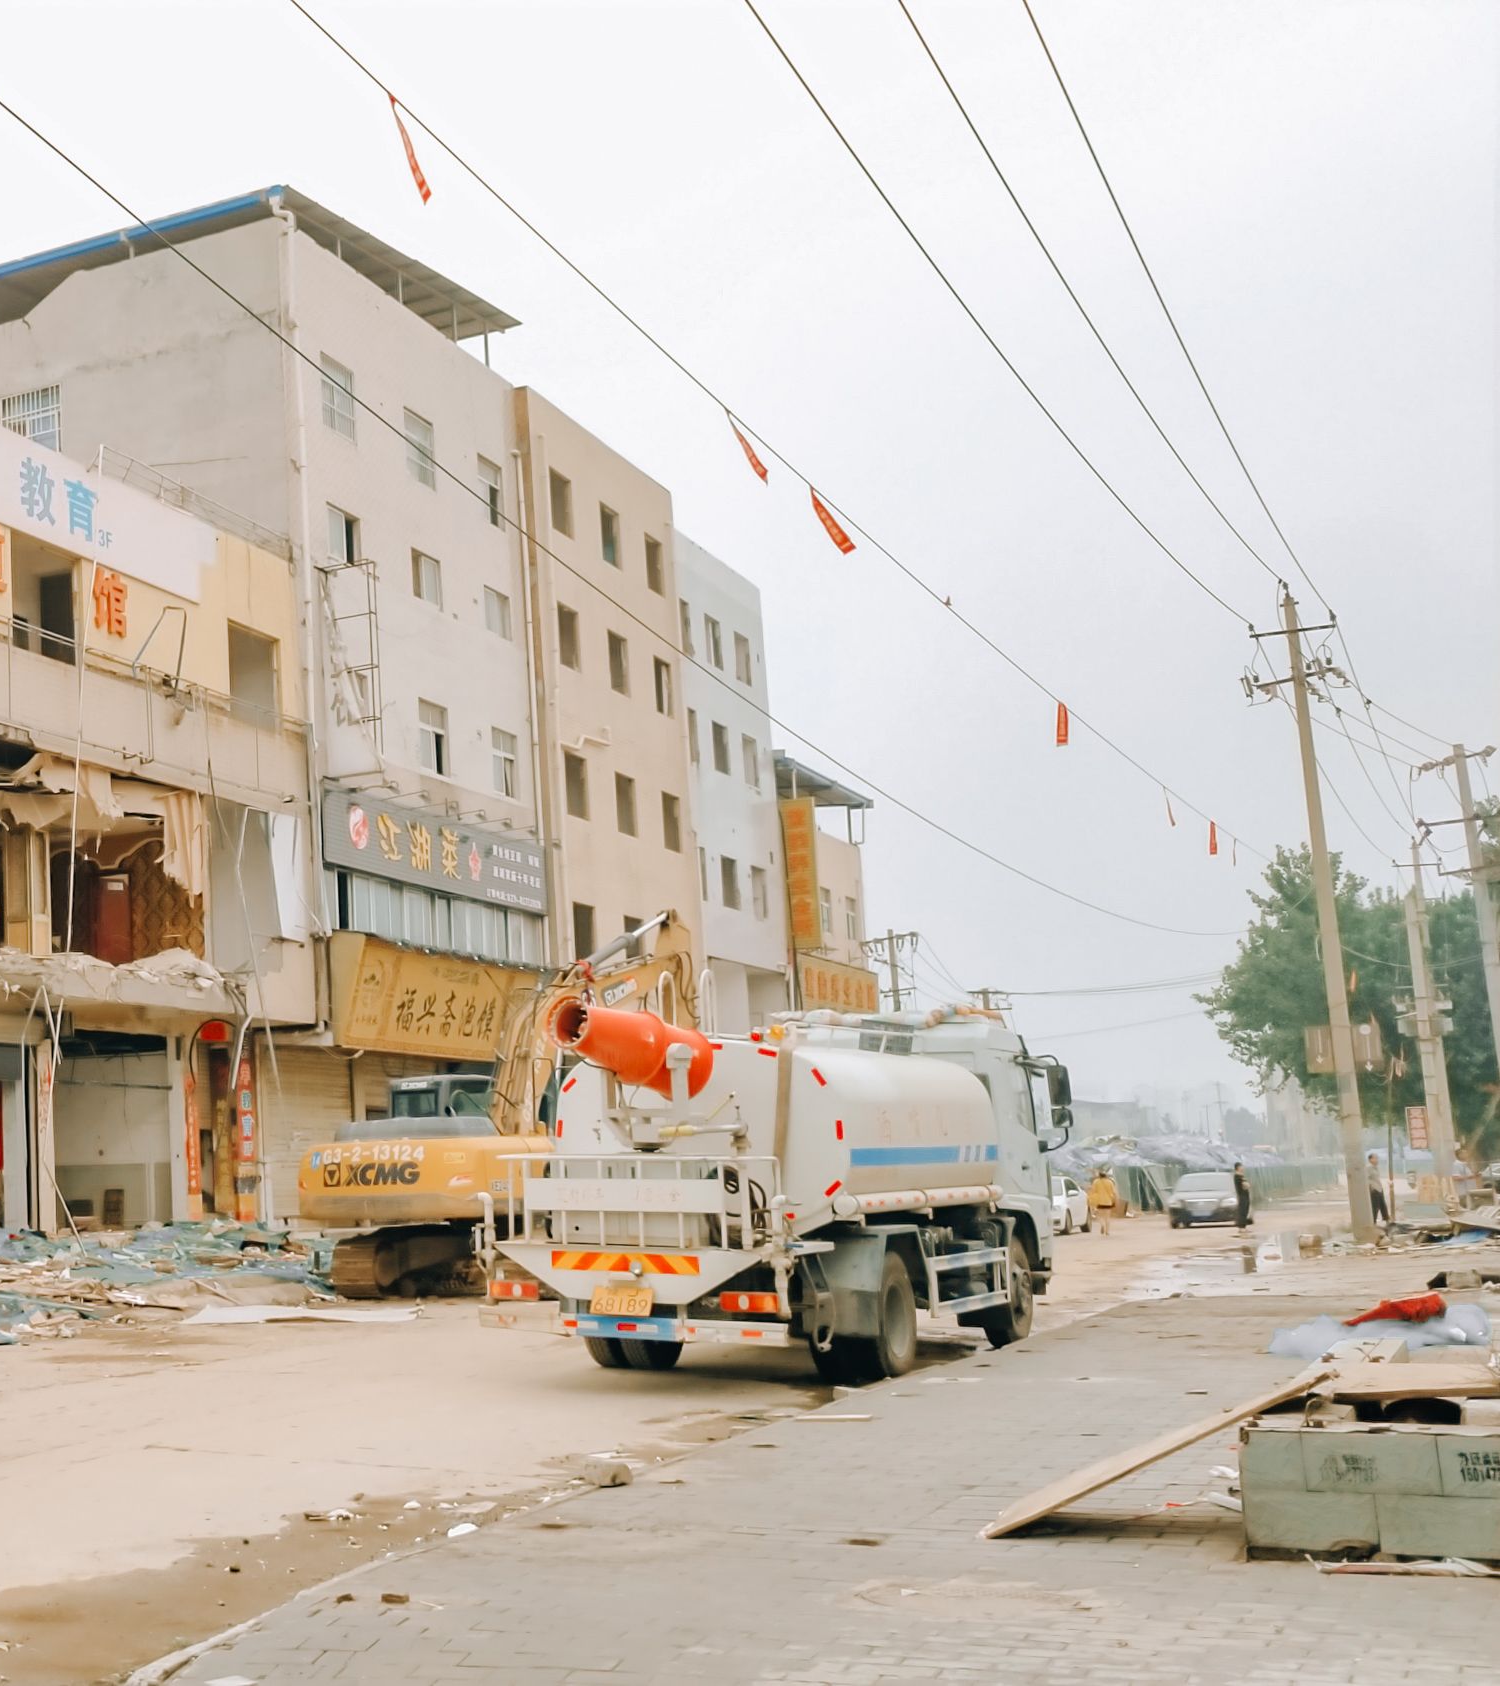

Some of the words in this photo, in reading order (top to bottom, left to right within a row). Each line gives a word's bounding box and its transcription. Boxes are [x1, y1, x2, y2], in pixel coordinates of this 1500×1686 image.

[19, 456, 98, 543] 教育
[98, 529, 113, 549] 3F
[323, 1145, 425, 1165] G3-2-13124
[343, 1161, 421, 1187] XCMG
[593, 1297, 648, 1313] 68189
